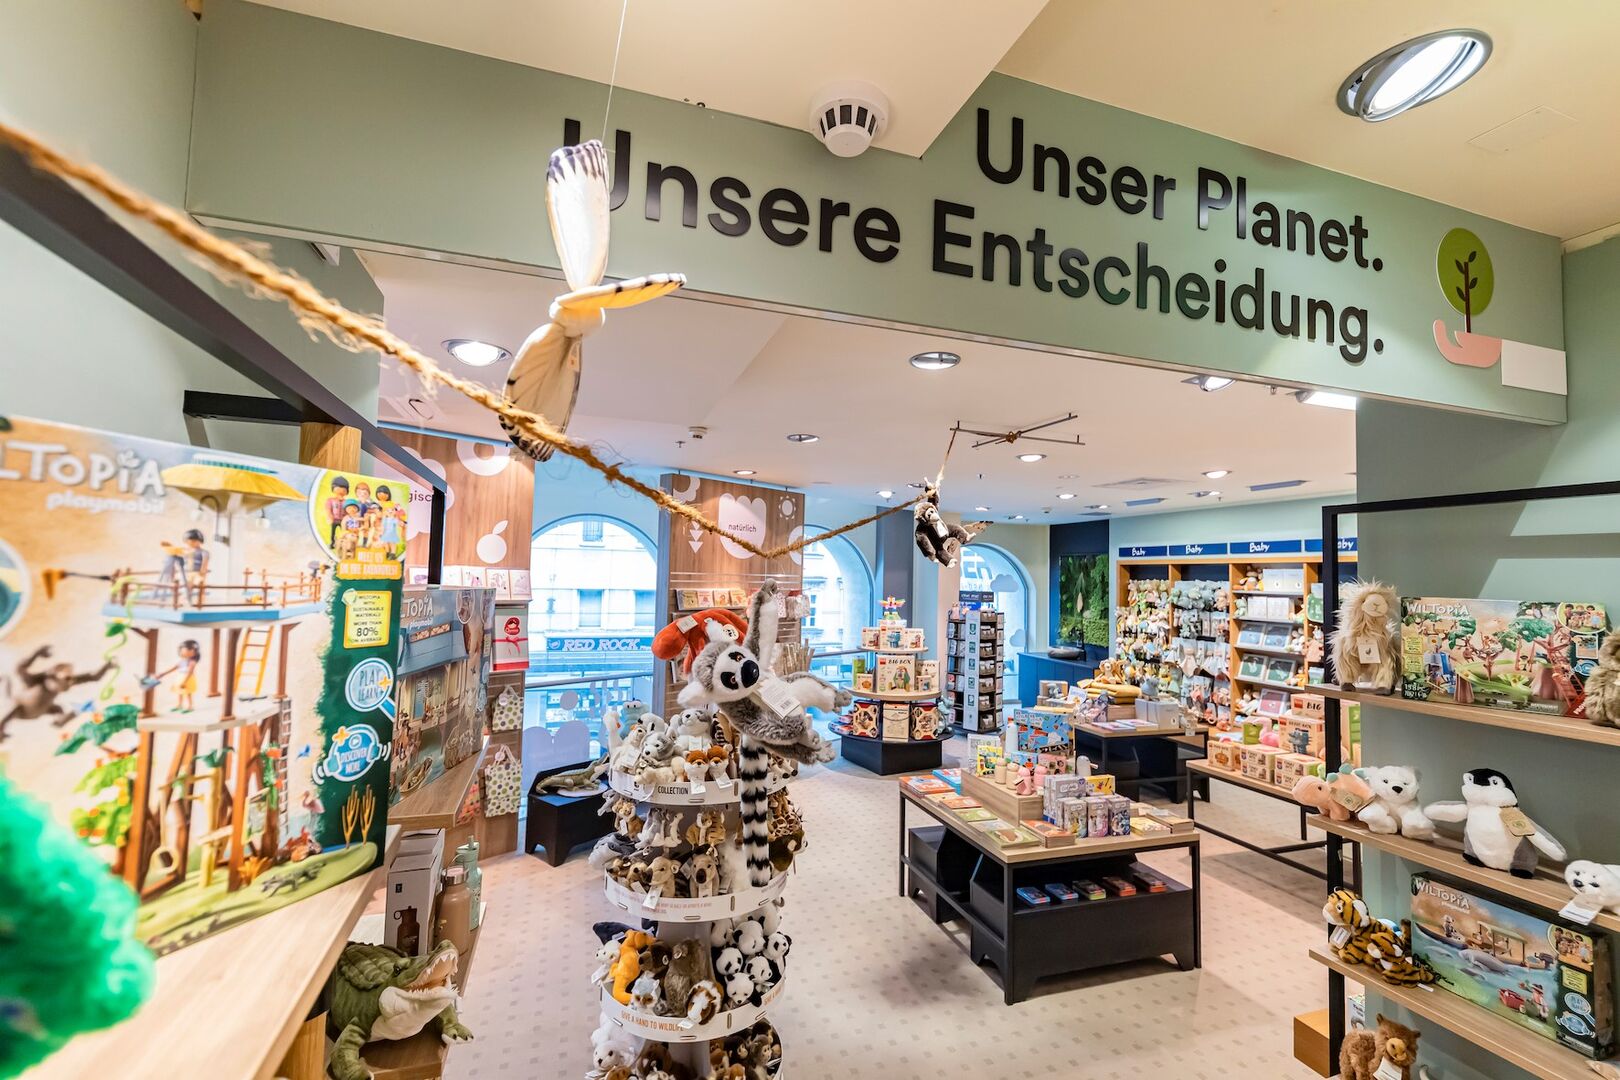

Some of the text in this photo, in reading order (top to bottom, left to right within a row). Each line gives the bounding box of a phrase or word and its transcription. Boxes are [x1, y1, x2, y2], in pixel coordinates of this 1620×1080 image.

[976, 108, 1384, 272] Unser Planet.
[564, 118, 1384, 364] Unsere Entscheidung.
[728, 523, 757, 533] natürlich
[1185, 544, 1204, 555] Baby
[1249, 542, 1271, 553] Baby
[1337, 538, 1354, 551] aby
[1131, 548, 1147, 557] Baby
[400, 594, 434, 618] TOPIA
[1406, 602, 1470, 616] WILTOPIA
[356, 626, 379, 637] 80%
[562, 639, 595, 652] RED
[597, 638, 640, 652] ROCK
[1306, 702, 1322, 711] BIG
[657, 785, 689, 795] COLLECTION
[1415, 878, 1470, 910] WILTOPIA
[636, 1018, 649, 1029] HAND
